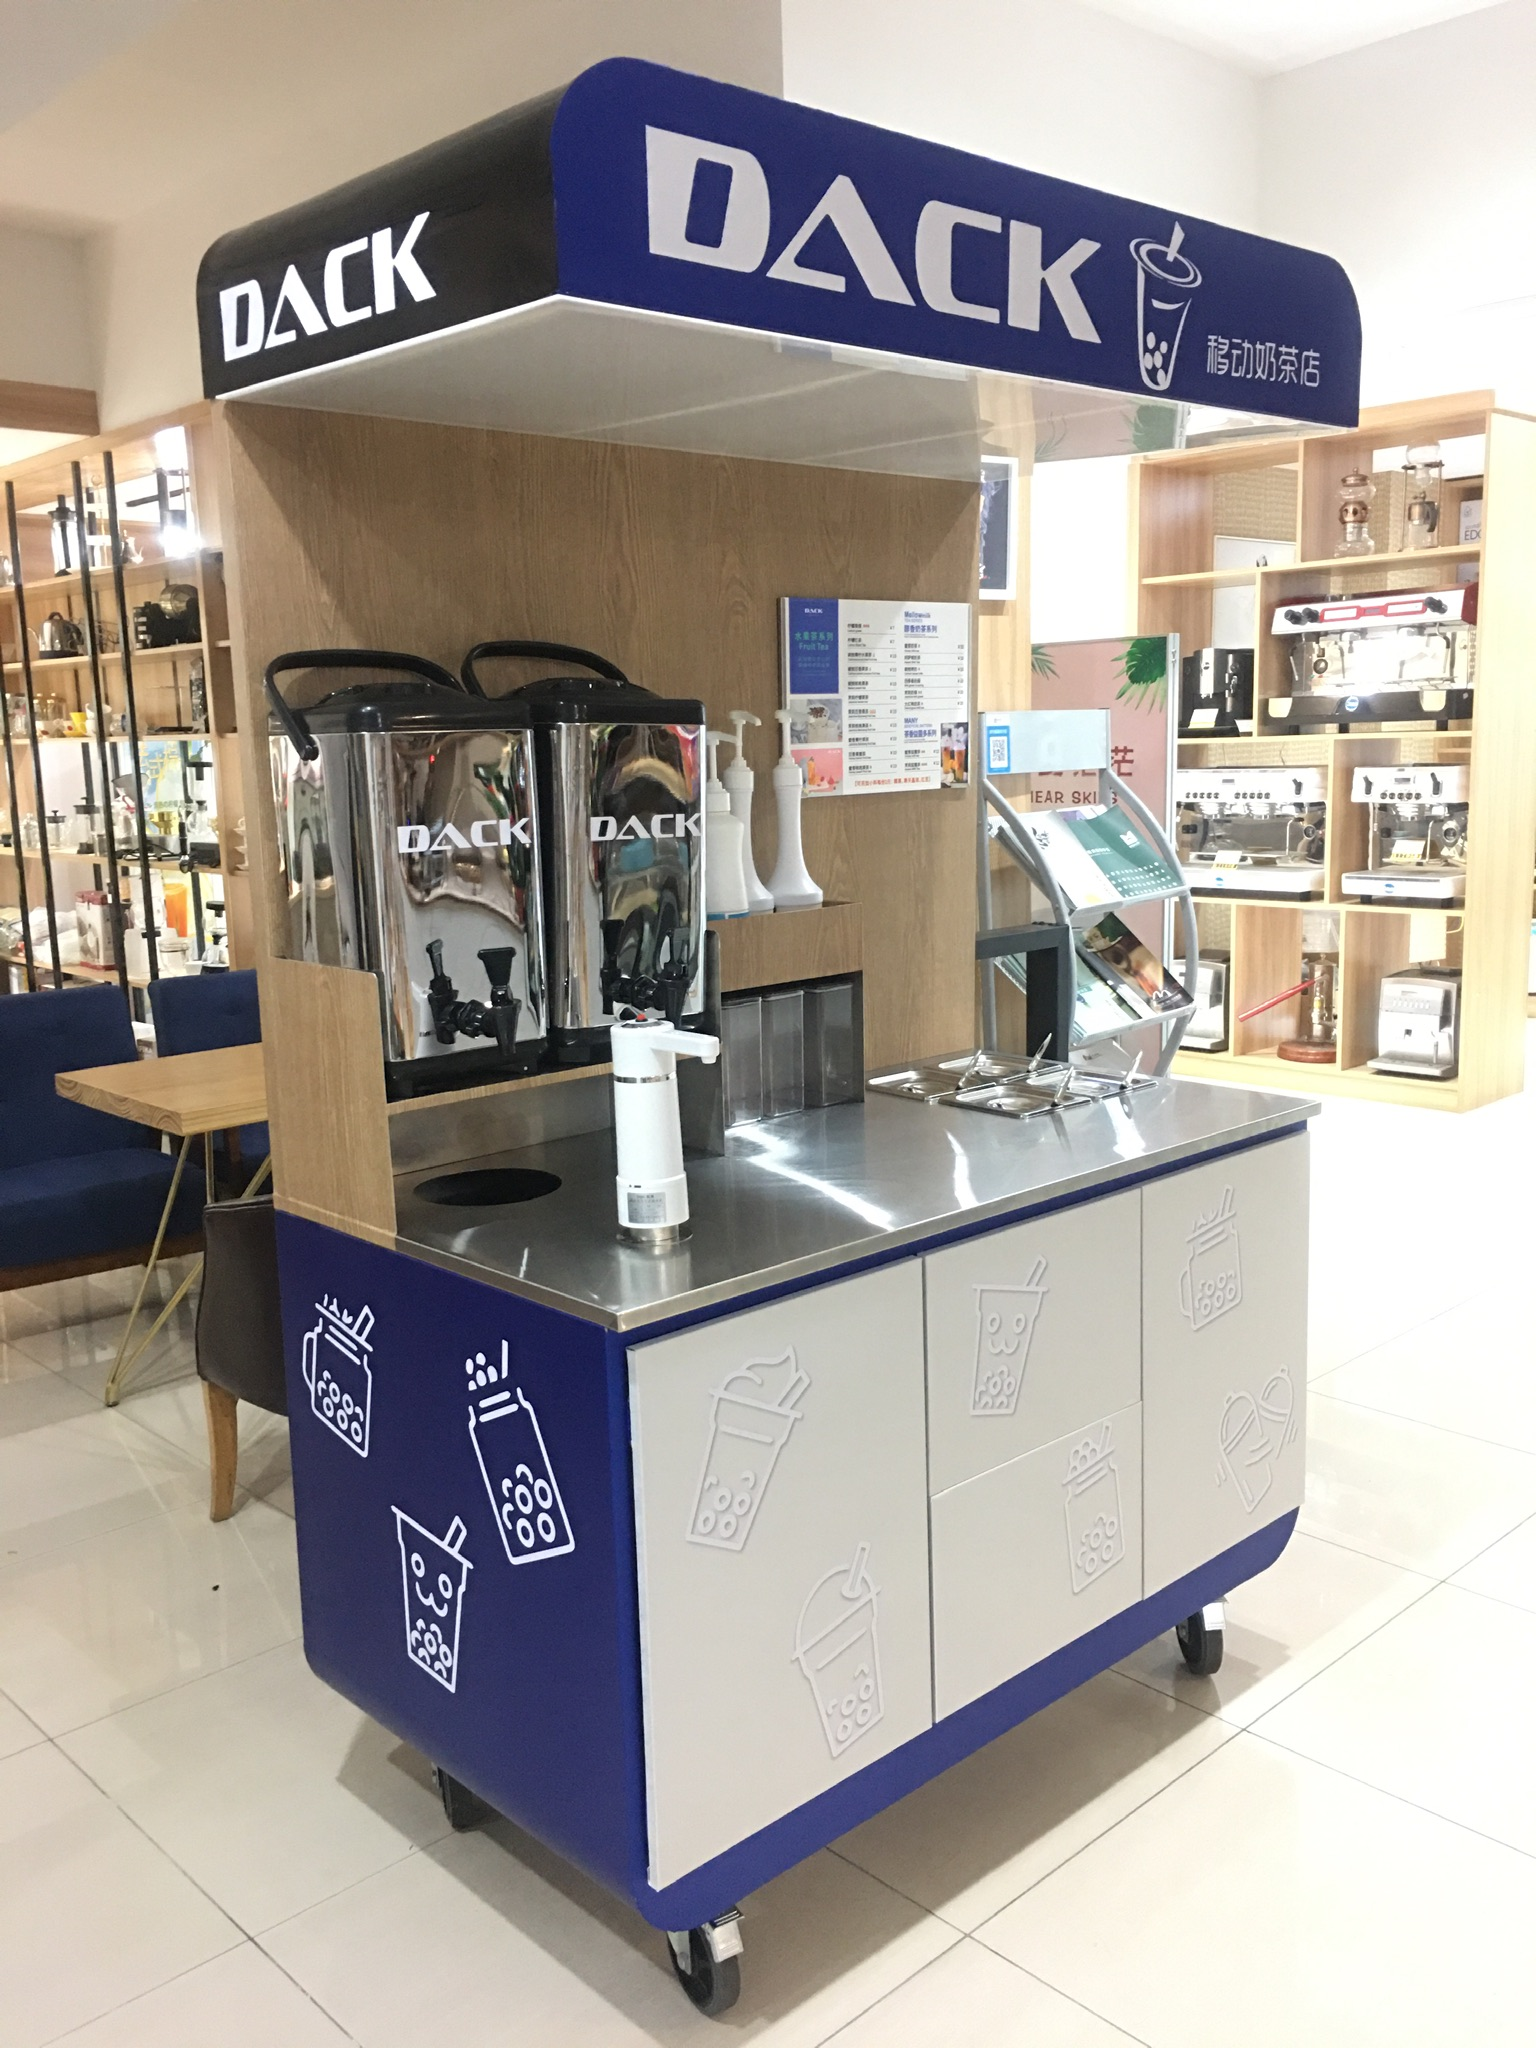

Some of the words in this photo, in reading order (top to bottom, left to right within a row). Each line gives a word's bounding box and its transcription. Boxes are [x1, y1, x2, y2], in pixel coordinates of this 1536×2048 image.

[644, 124, 1102, 344] DACK
[219, 211, 436, 362] DACK
[1207, 335, 1321, 388] 移动奶茶店
[398, 817, 531, 854] DACK
[590, 812, 703, 843] DACK
